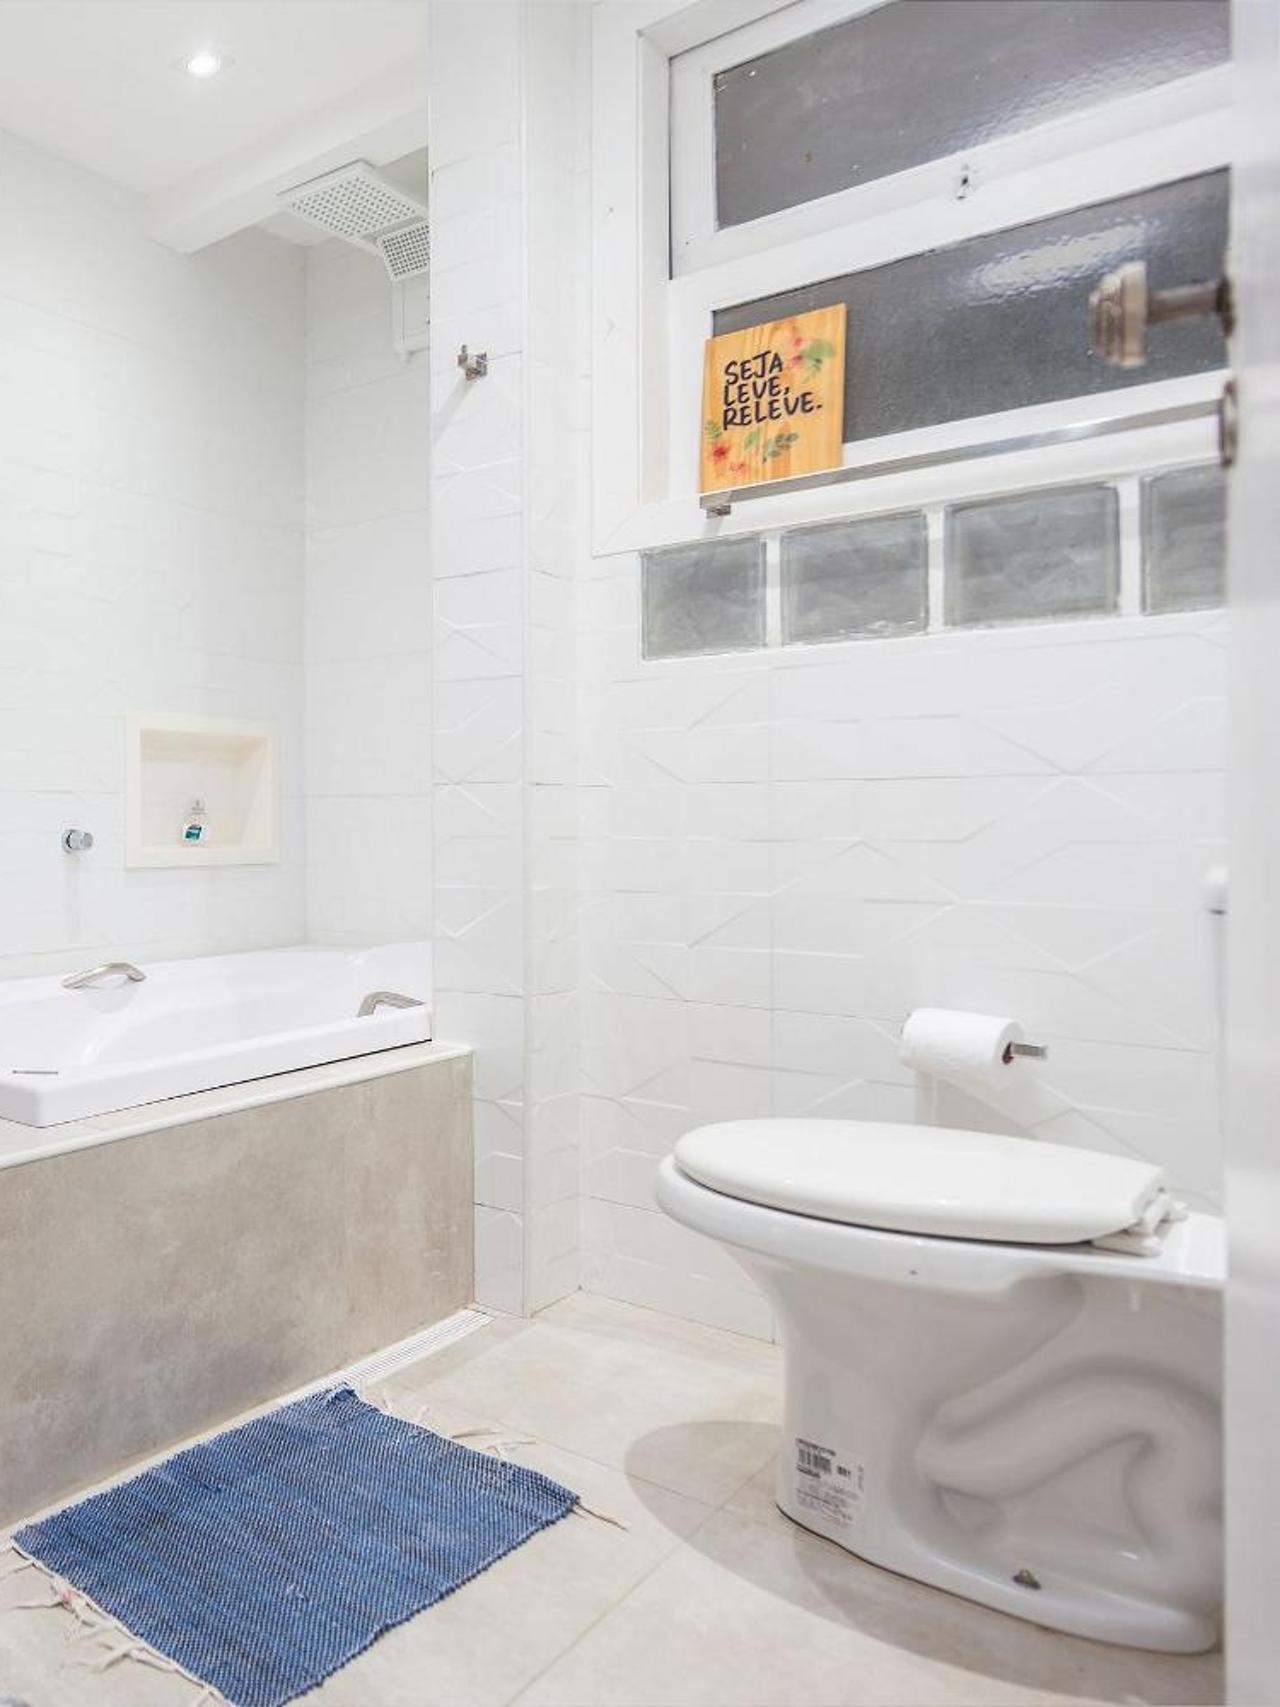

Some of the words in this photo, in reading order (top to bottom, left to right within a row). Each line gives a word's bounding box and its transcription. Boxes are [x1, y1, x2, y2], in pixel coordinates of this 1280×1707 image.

[725, 351, 783, 385] SEJA
[724, 376, 789, 406] LEVE,
[723, 392, 823, 430] RELEVE.
